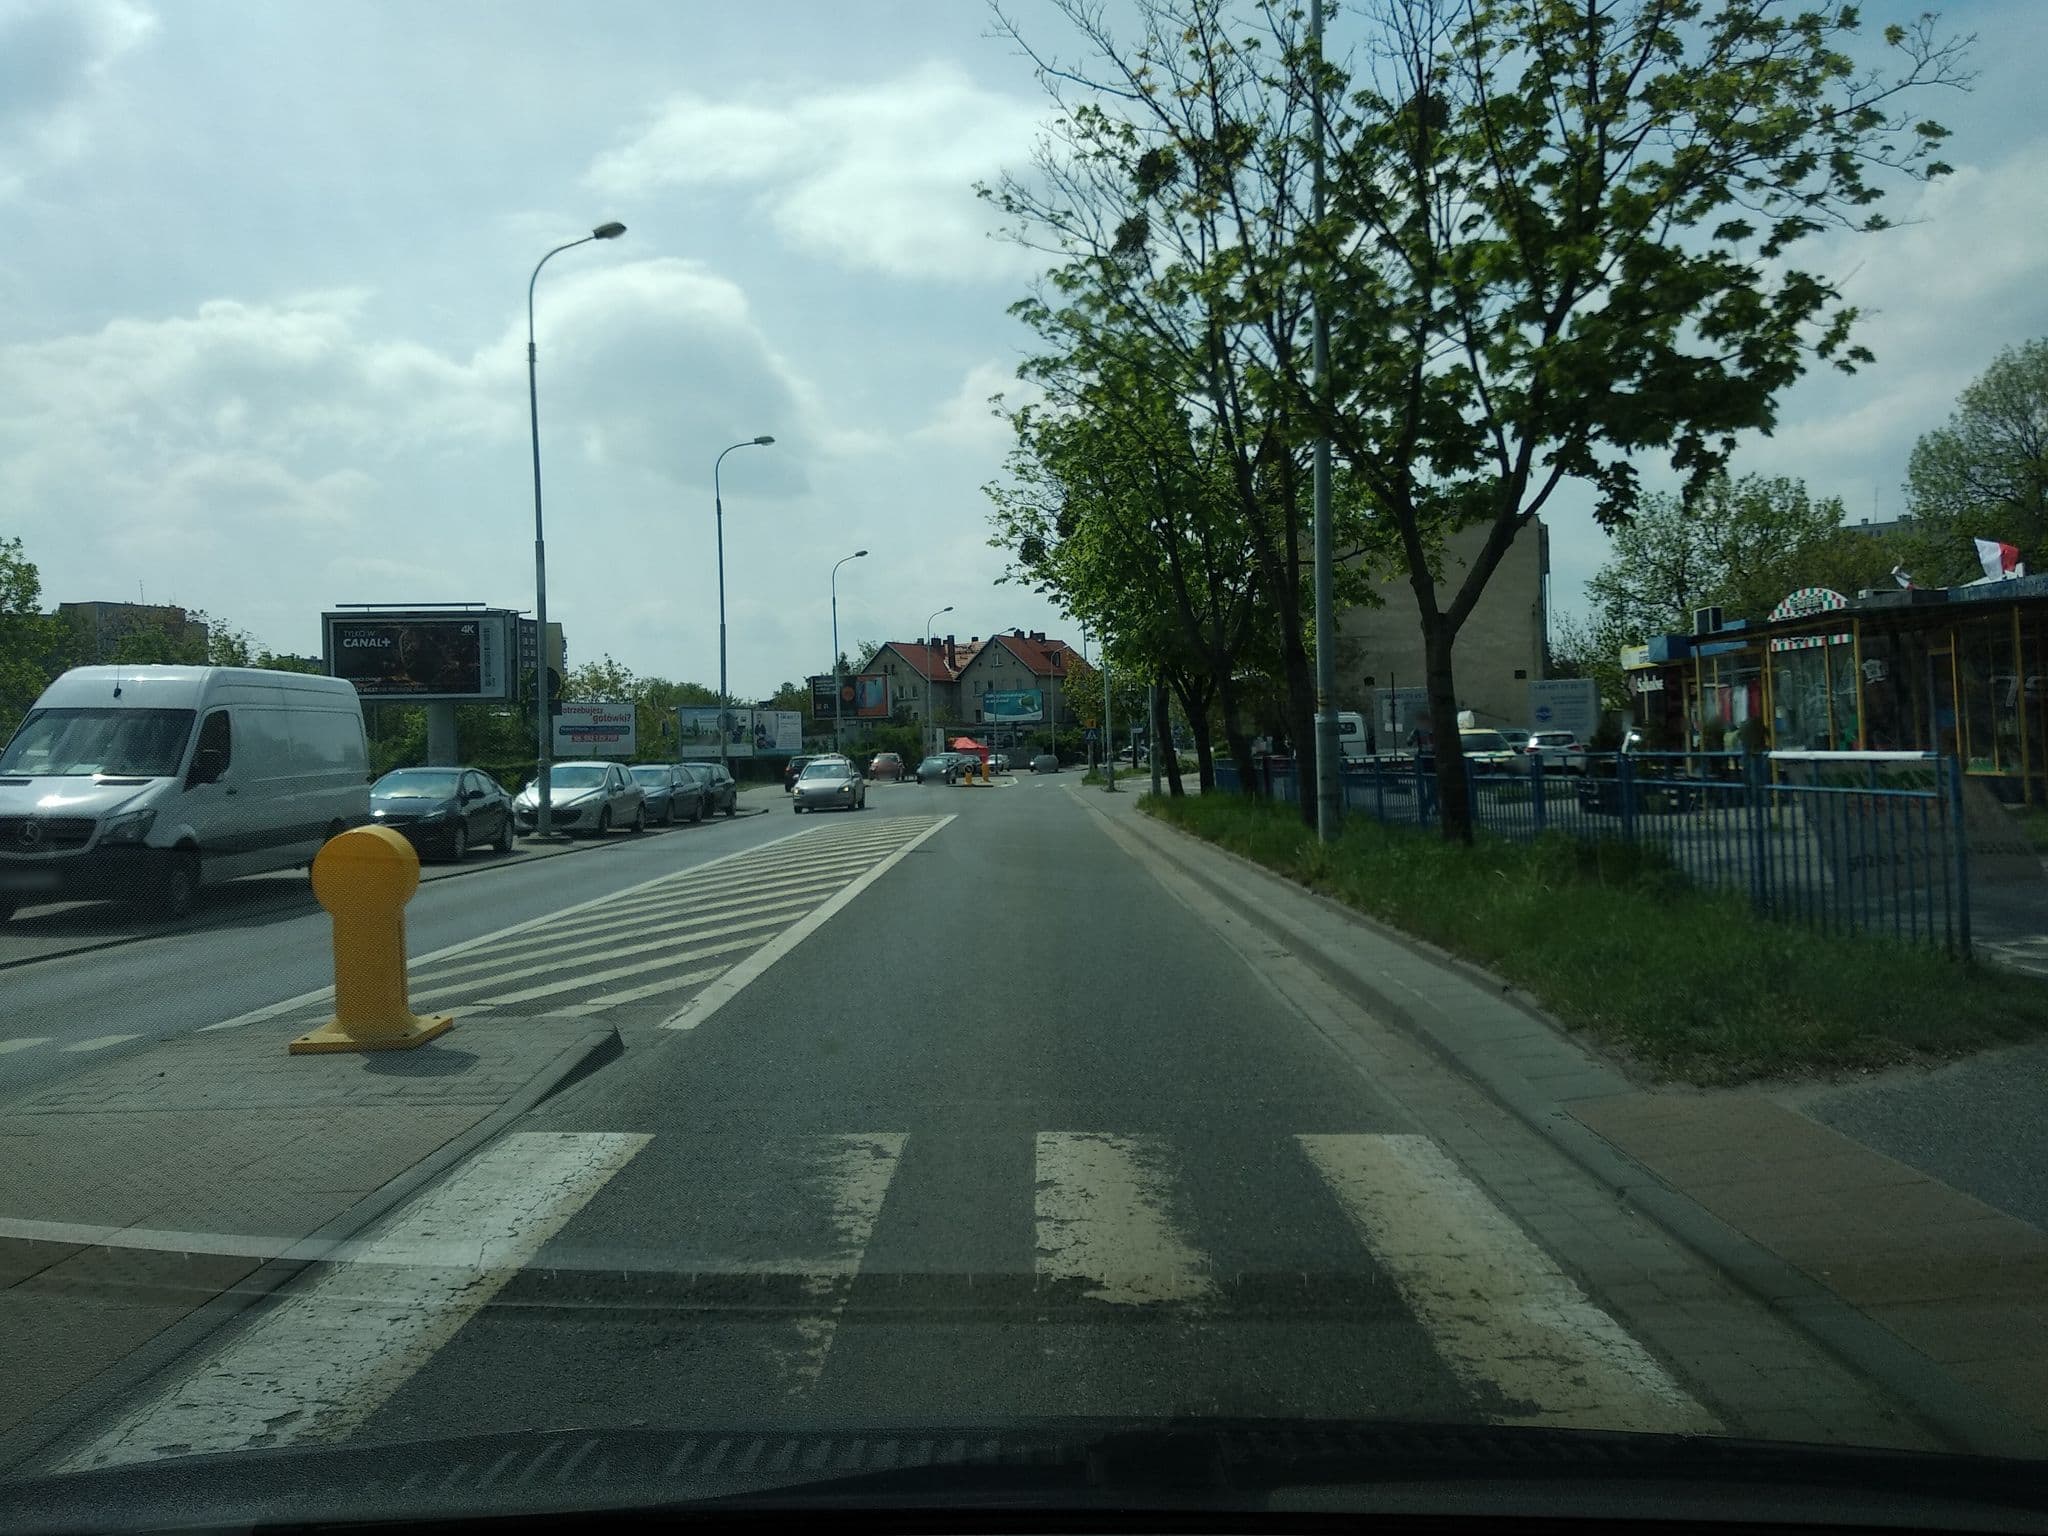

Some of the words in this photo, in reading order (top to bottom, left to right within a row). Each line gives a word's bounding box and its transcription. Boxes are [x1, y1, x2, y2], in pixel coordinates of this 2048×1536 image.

[461, 625, 475, 634] 4K
[343, 637, 391, 648] CANAL+
[562, 705, 604, 716] otrzebujesz
